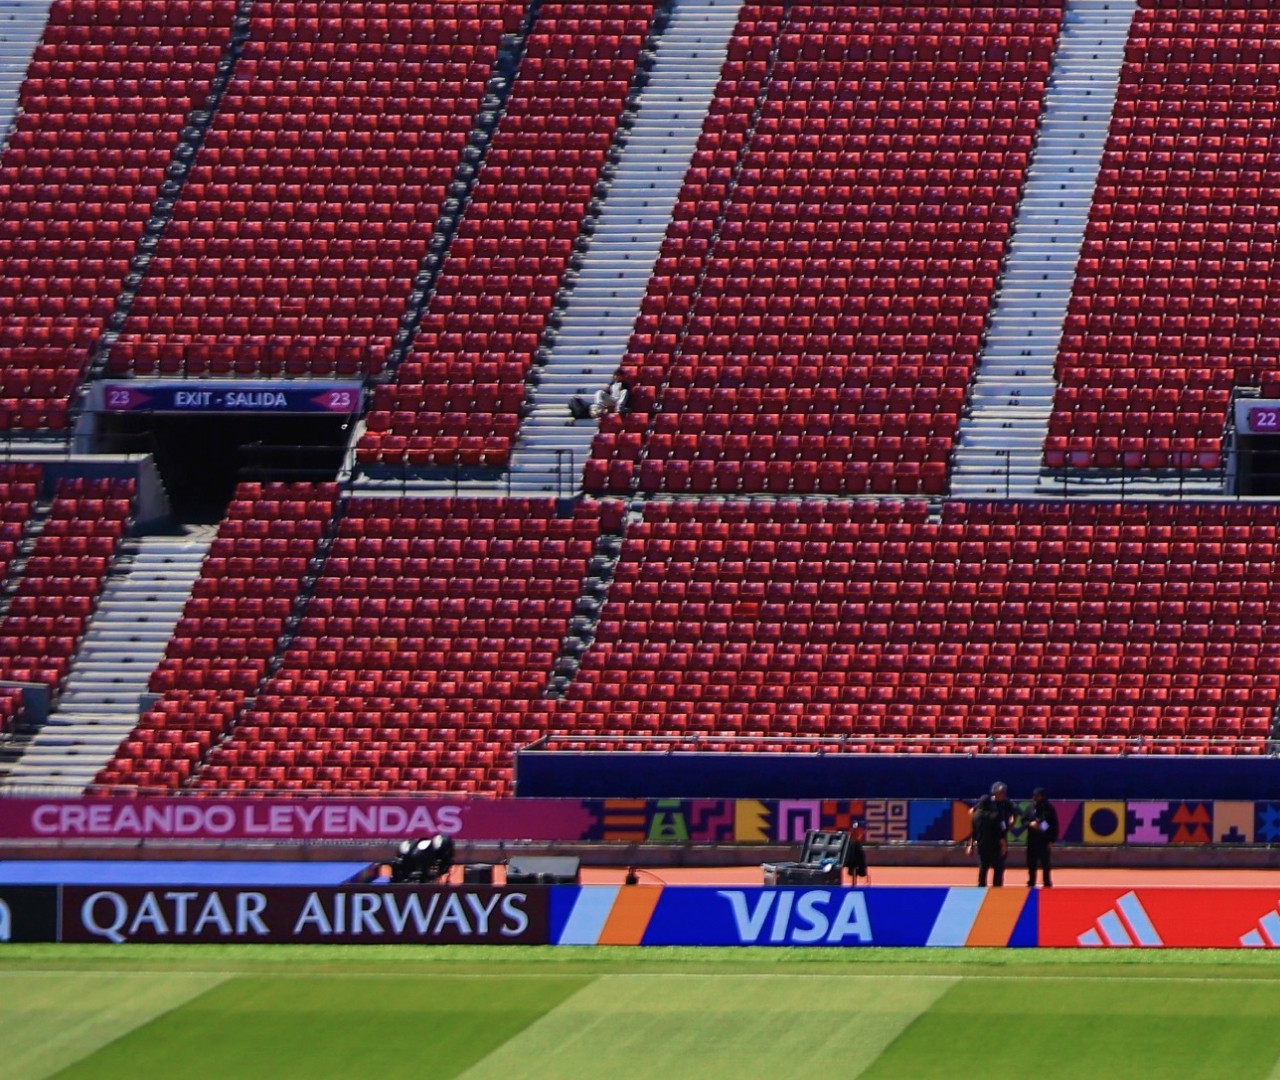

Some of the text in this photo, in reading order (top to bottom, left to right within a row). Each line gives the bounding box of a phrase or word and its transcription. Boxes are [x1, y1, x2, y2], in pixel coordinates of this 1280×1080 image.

[111, 391, 129, 404] 23
[176, 392, 212, 405] EXIT
[226, 393, 287, 405] SALIDA
[331, 393, 350, 406] 23
[1258, 413, 1276, 425] 22
[33, 805, 463, 835] CREANDO LEYENDAS
[82, 891, 528, 942] QATAR AIRWAYS
[718, 890, 872, 941] VISA
